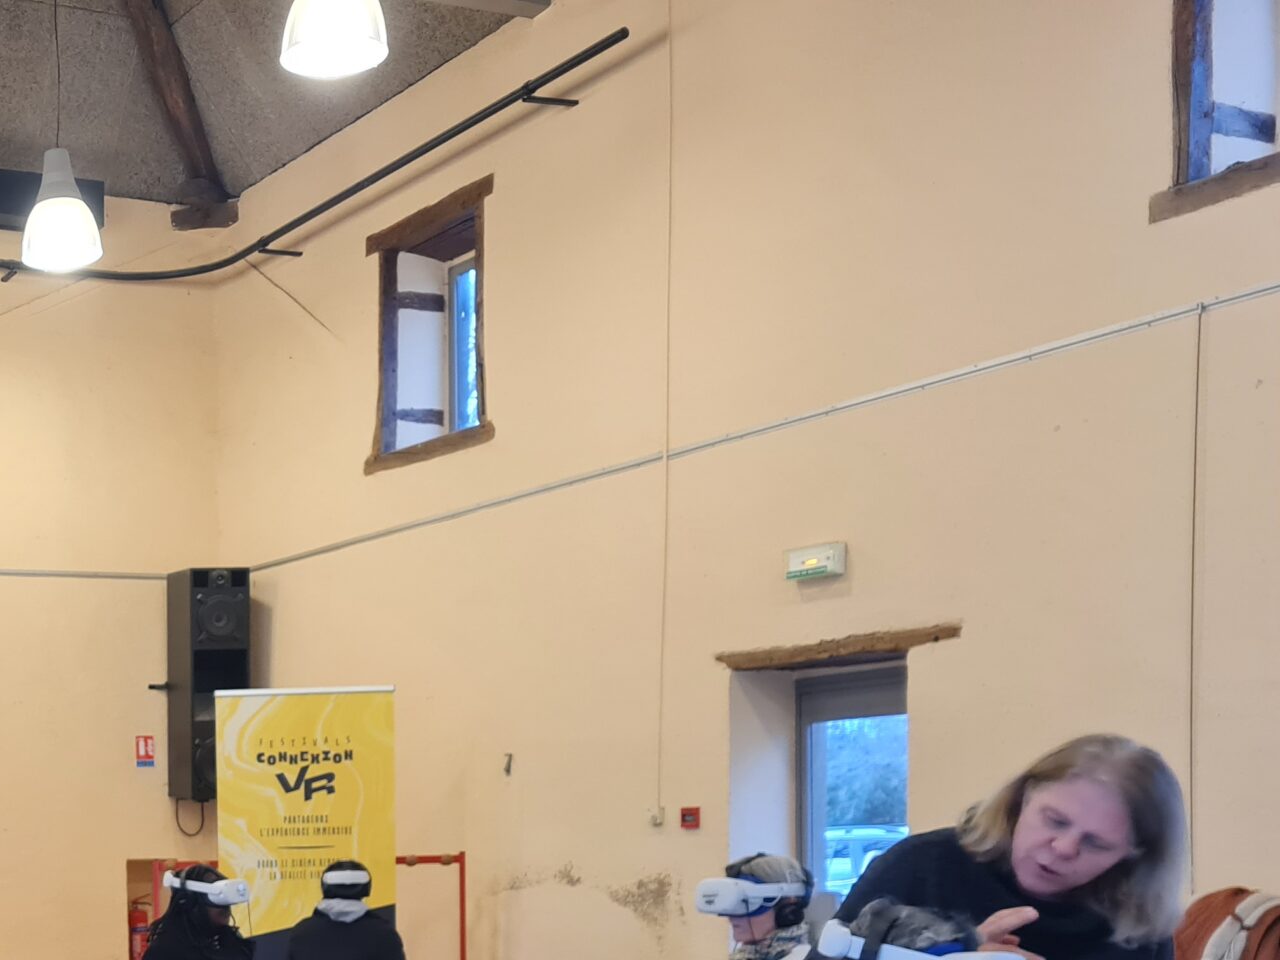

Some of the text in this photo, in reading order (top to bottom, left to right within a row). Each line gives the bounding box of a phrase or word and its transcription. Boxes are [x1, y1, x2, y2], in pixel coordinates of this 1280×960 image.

[258, 735, 352, 749] FESTIVALS
[256, 749, 353, 766] CONNEXION
[275, 765, 336, 802] VR
